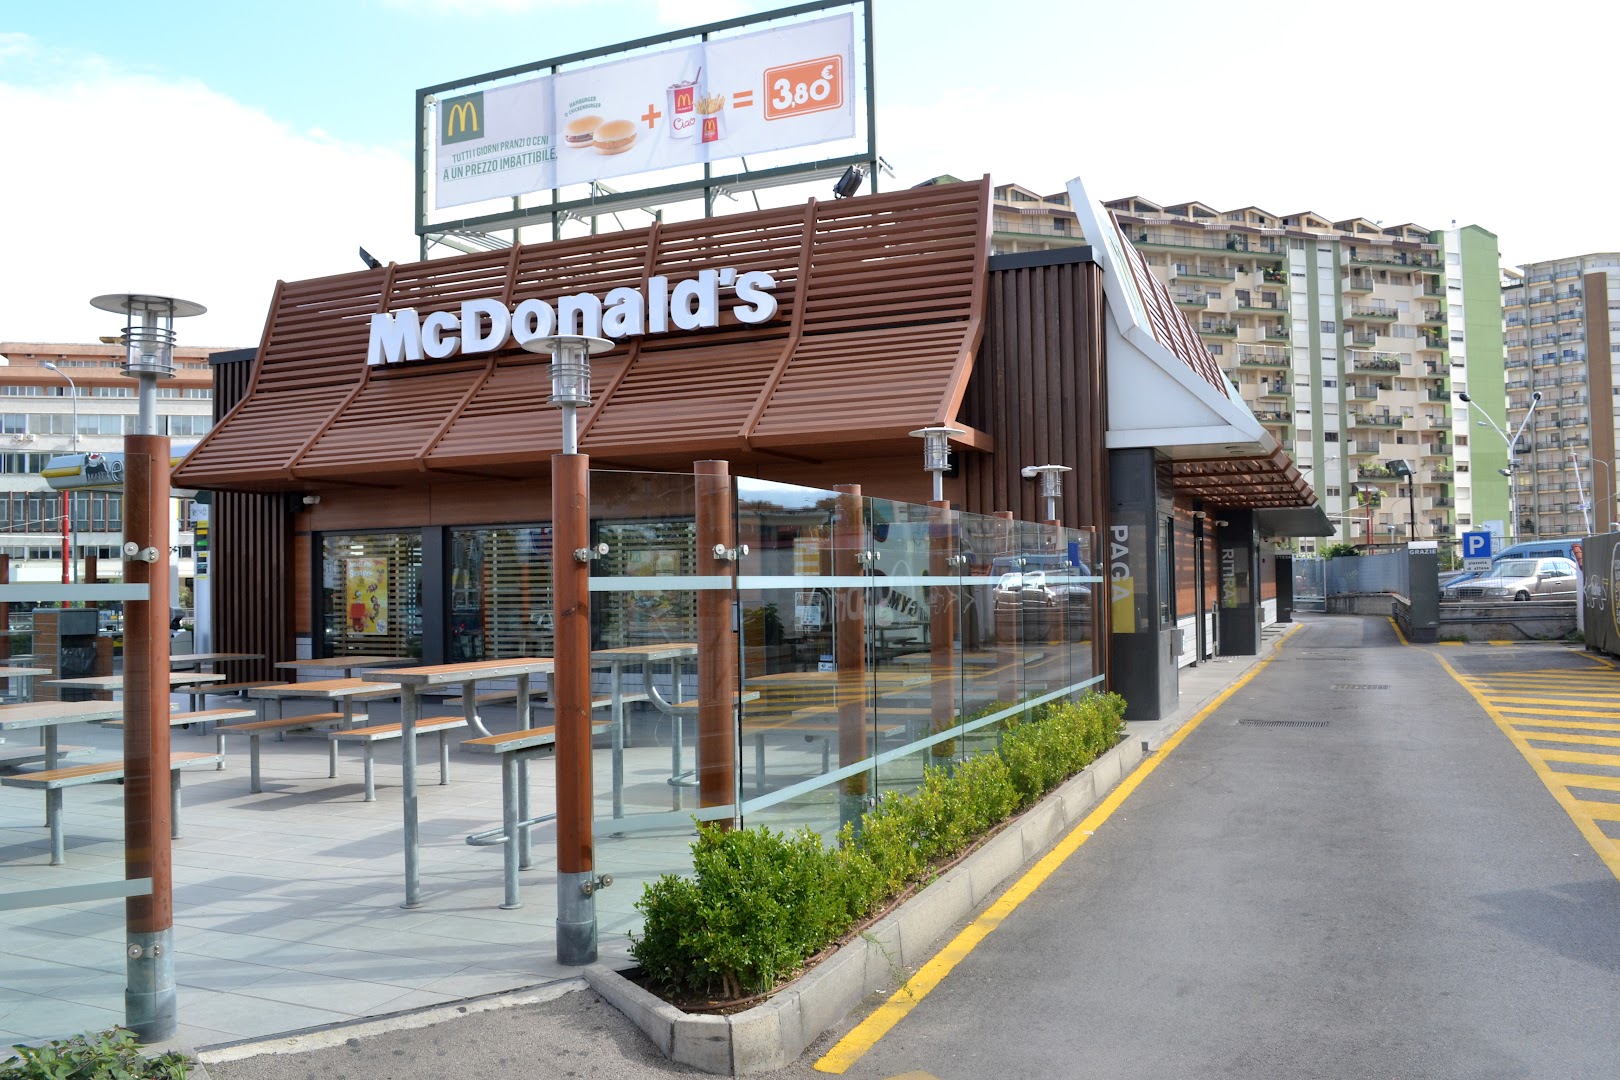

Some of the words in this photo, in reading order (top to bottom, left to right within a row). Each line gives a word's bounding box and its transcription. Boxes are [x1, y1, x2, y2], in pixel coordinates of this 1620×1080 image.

[569, 96, 597, 108] HAMBURGER
[673, 117, 696, 130] Ciao
[452, 152, 472, 163] TUTTI
[476, 144, 500, 157] GIORNI
[500, 138, 525, 151] PRANZI
[526, 137, 531, 146] O
[532, 135, 549, 146] CENI
[443, 168, 450, 181] A
[451, 165, 464, 179] UN
[465, 159, 498, 176] PREZZO
[367, 267, 778, 366] McDonald's
[1469, 535, 1485, 555] P
[1110, 525, 1130, 603] PAGA
[1222, 548, 1236, 600] RITIRA
